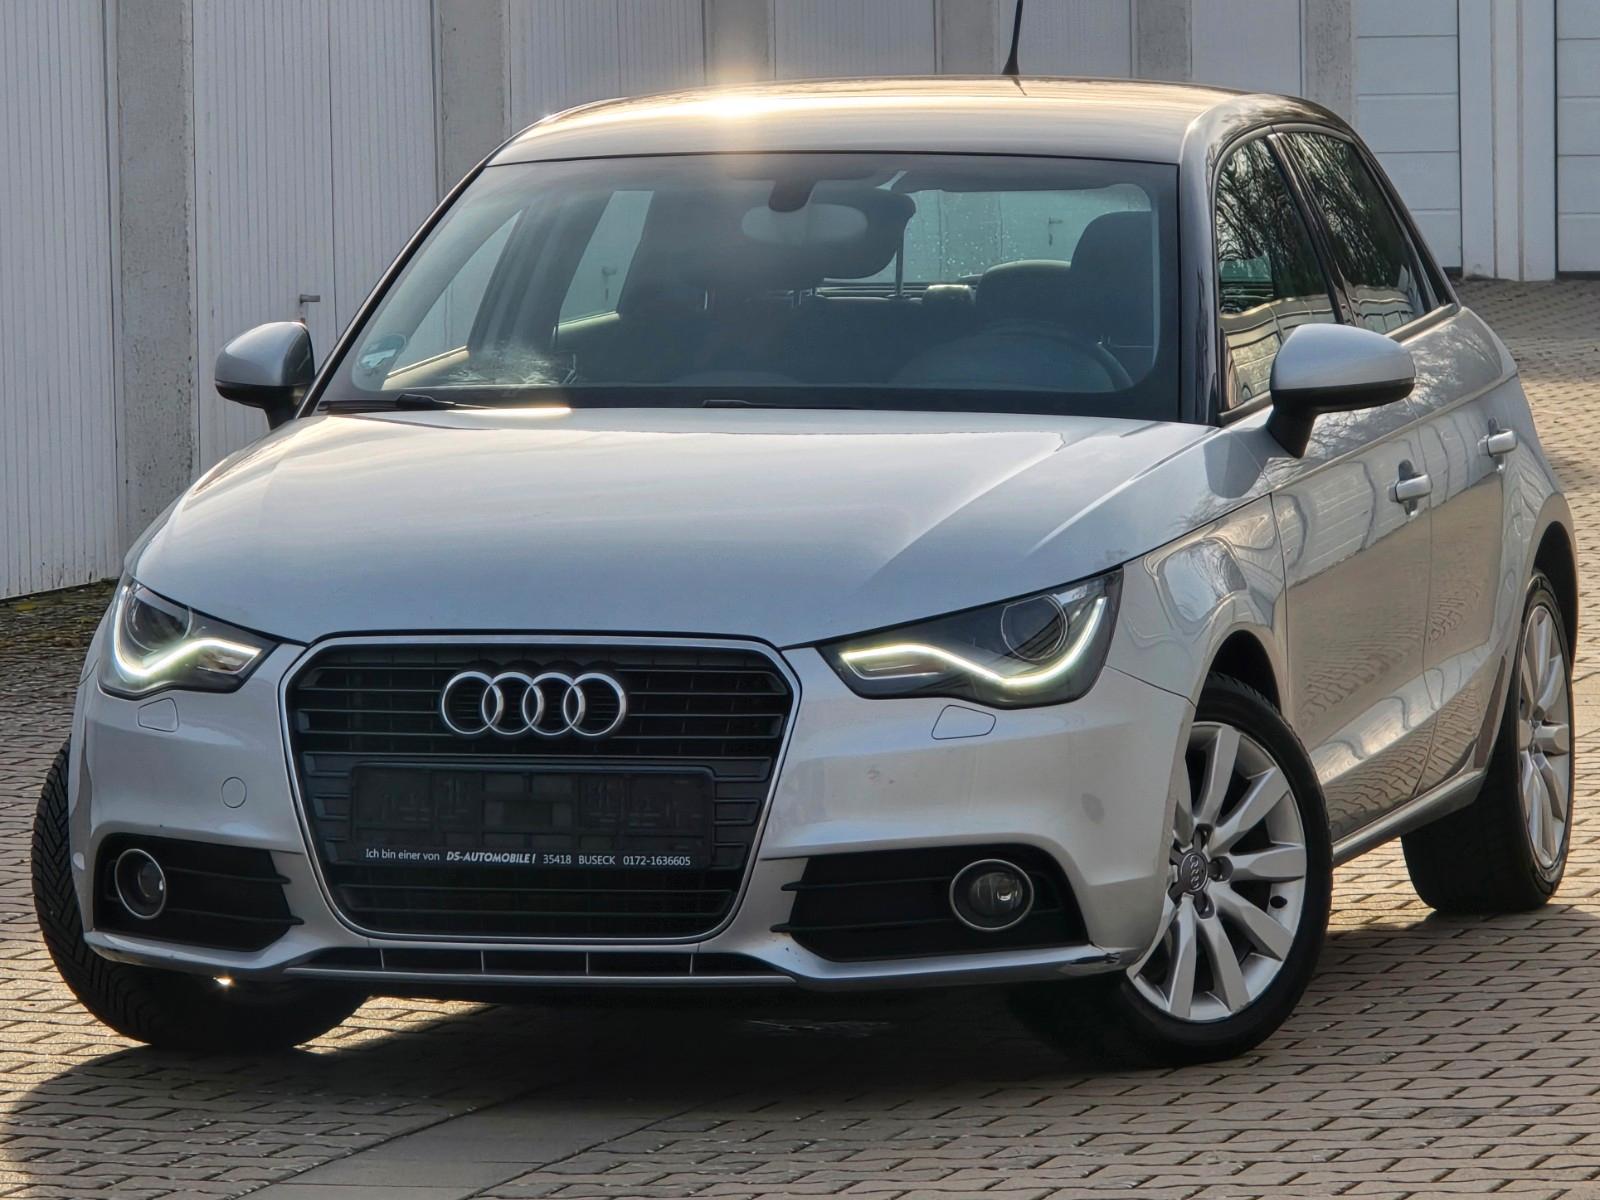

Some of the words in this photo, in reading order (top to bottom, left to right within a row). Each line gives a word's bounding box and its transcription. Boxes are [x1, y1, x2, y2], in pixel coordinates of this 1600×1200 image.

[365, 848, 380, 860] Ich
[381, 848, 396, 860] bin
[397, 850, 421, 861] einer
[422, 852, 440, 862] von
[543, 854, 572, 865] 35418
[578, 855, 616, 866] BUSECK
[622, 855, 691, 866] 0172-1636605
